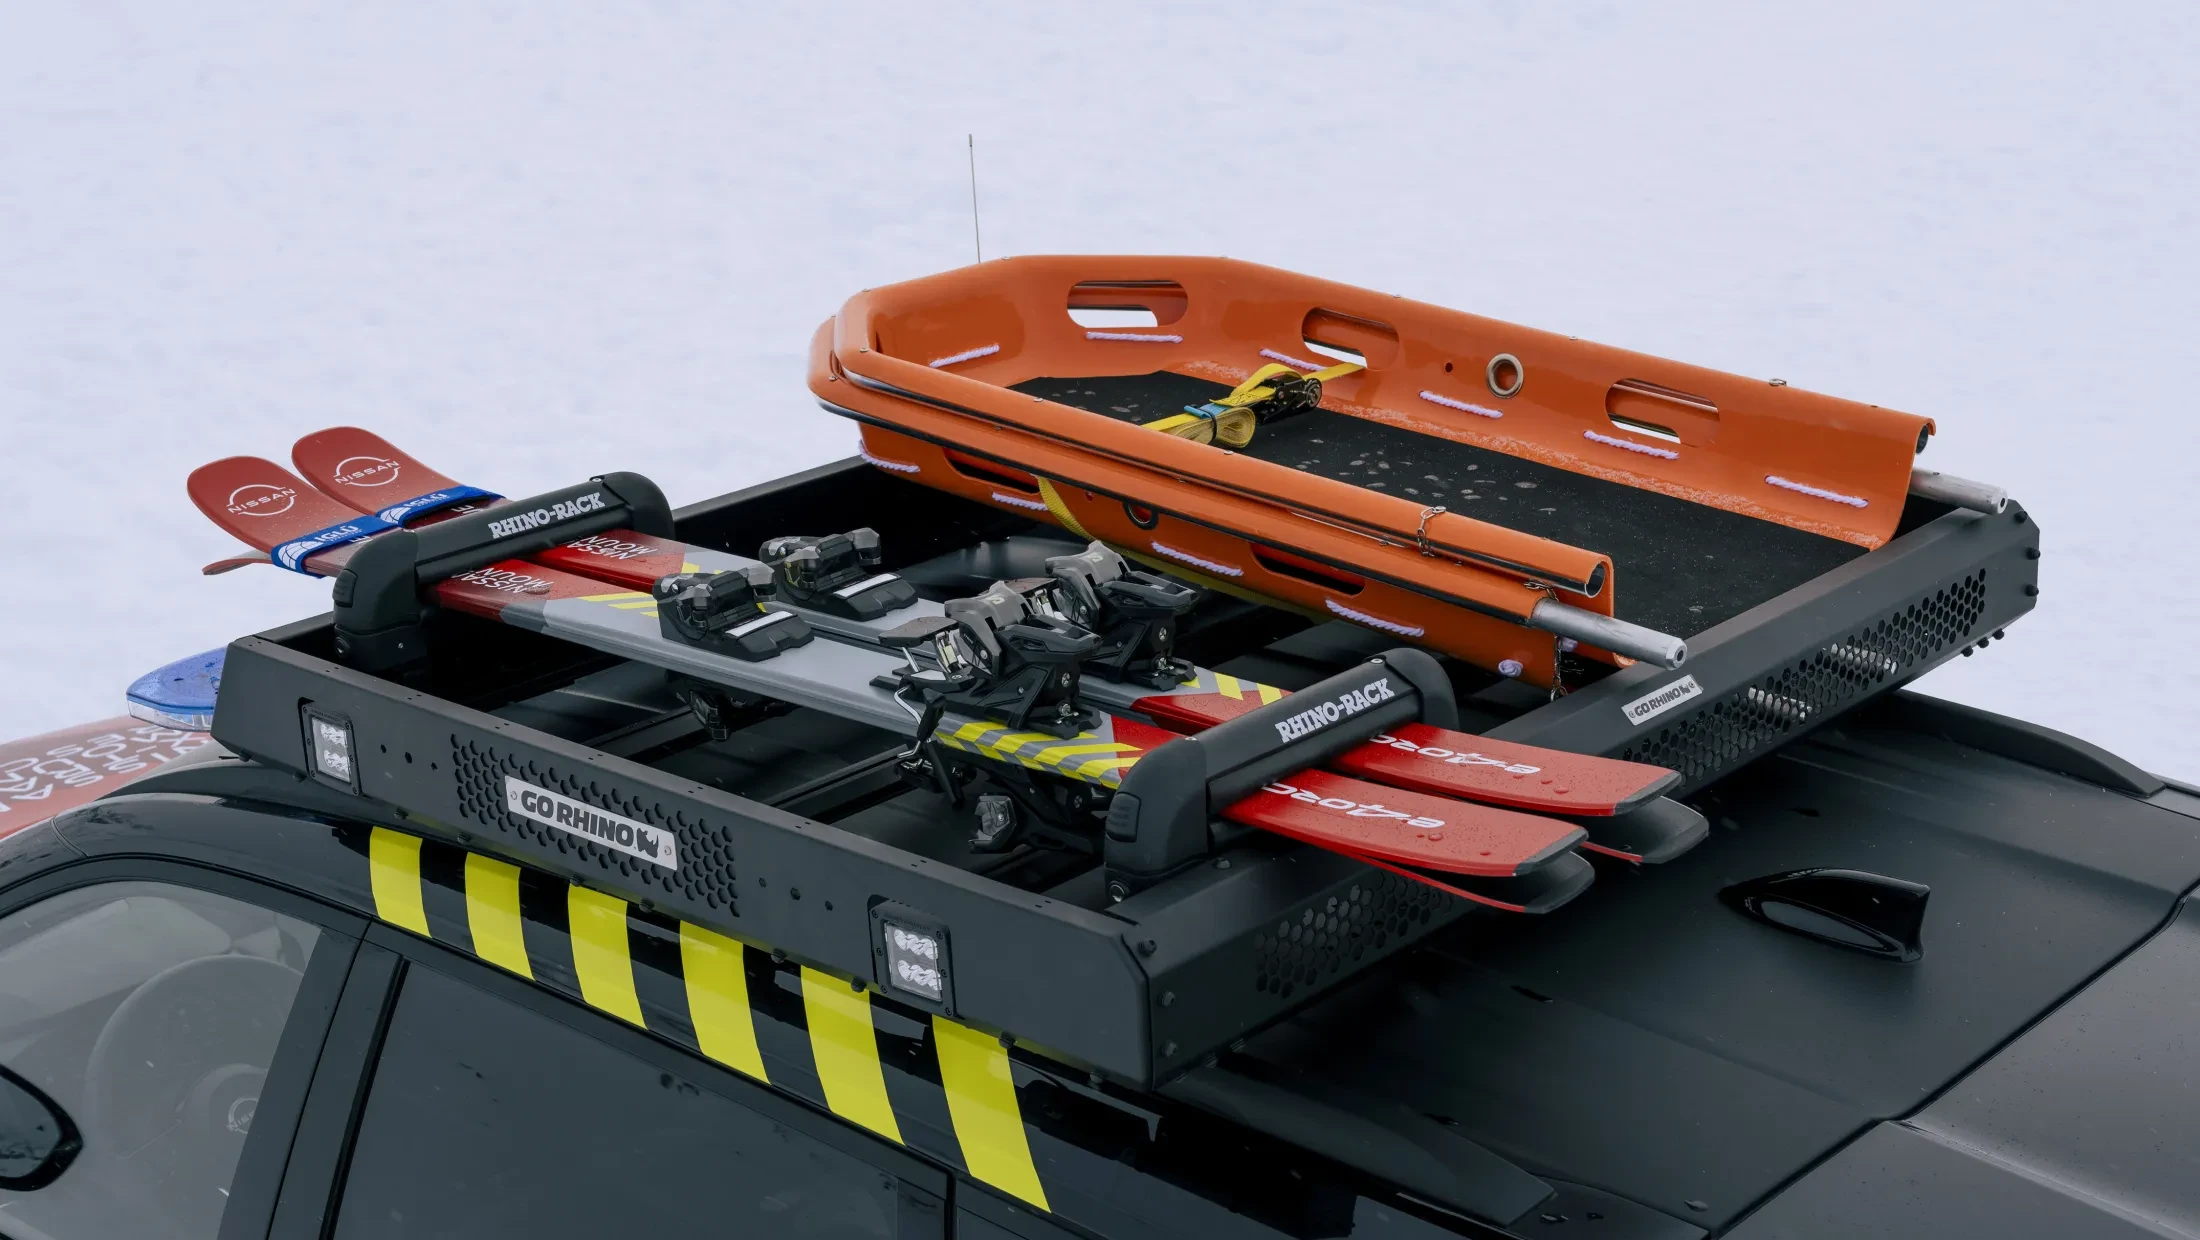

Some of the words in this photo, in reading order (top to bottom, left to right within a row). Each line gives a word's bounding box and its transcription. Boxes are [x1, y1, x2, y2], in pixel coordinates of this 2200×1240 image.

[335, 460, 399, 484] NISSAN
[228, 488, 296, 513] NISSAN
[488, 491, 605, 539] RHINO-RACK
[561, 540, 638, 560] NISSA
[1275, 677, 1395, 743] RHINO-RACK
[1634, 702, 1651, 717] GO
[1648, 687, 1682, 711] RHINO
[520, 790, 554, 819] GO
[556, 801, 635, 848] RHINO
